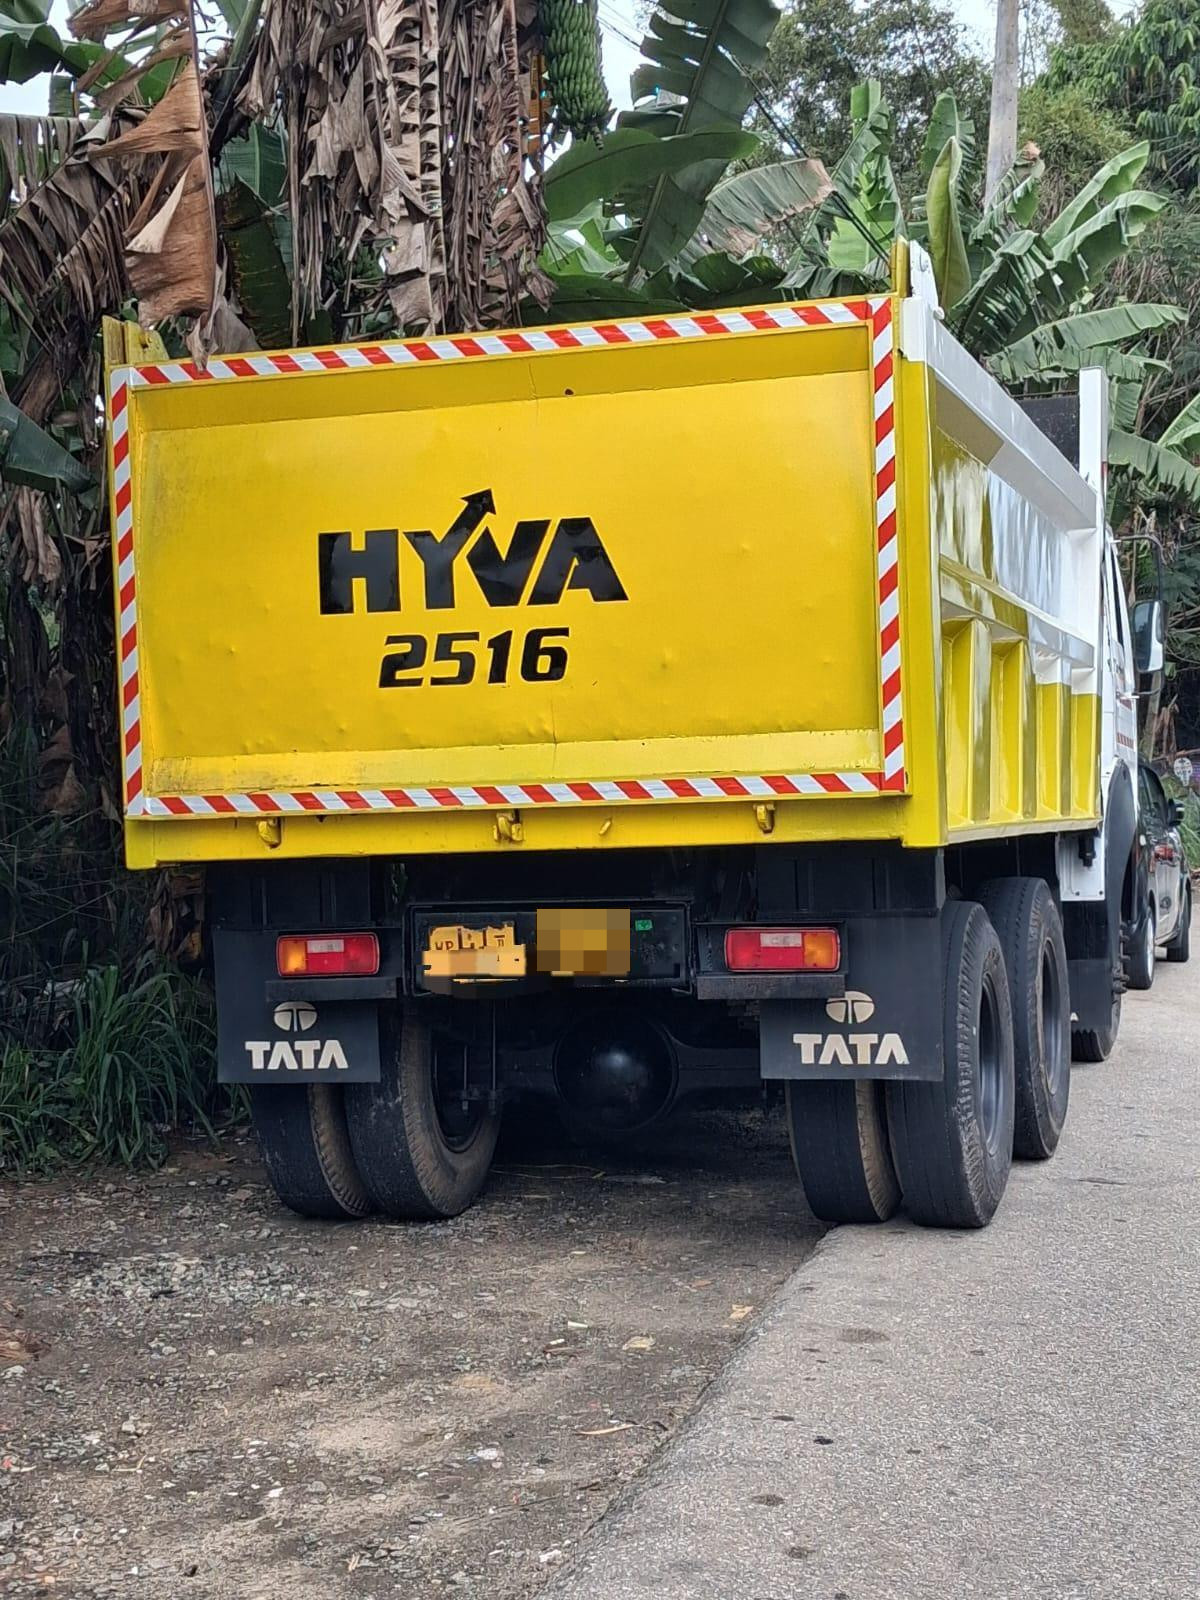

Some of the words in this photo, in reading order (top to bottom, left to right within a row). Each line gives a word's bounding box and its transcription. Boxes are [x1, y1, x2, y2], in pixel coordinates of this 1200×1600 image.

[318, 488, 629, 615] HYVA
[378, 627, 570, 688] 2516
[245, 1040, 349, 1070] TATA
[792, 1033, 910, 1065] TATA
